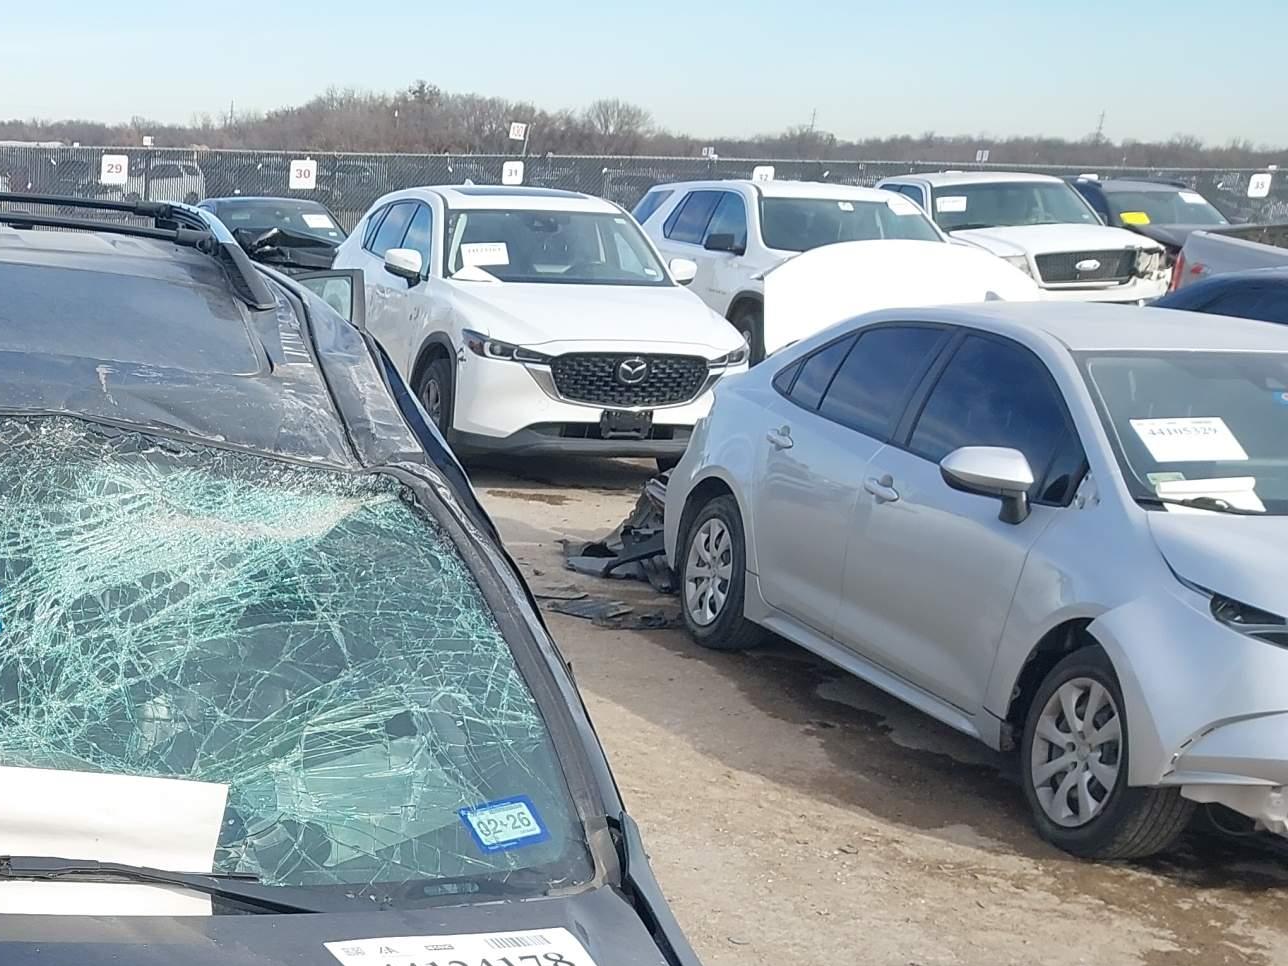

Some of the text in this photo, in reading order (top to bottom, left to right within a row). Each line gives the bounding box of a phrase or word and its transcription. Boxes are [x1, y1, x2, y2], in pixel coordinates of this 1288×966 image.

[106, 163, 123, 174] 29
[295, 168, 311, 179] 30
[507, 168, 518, 177] 31
